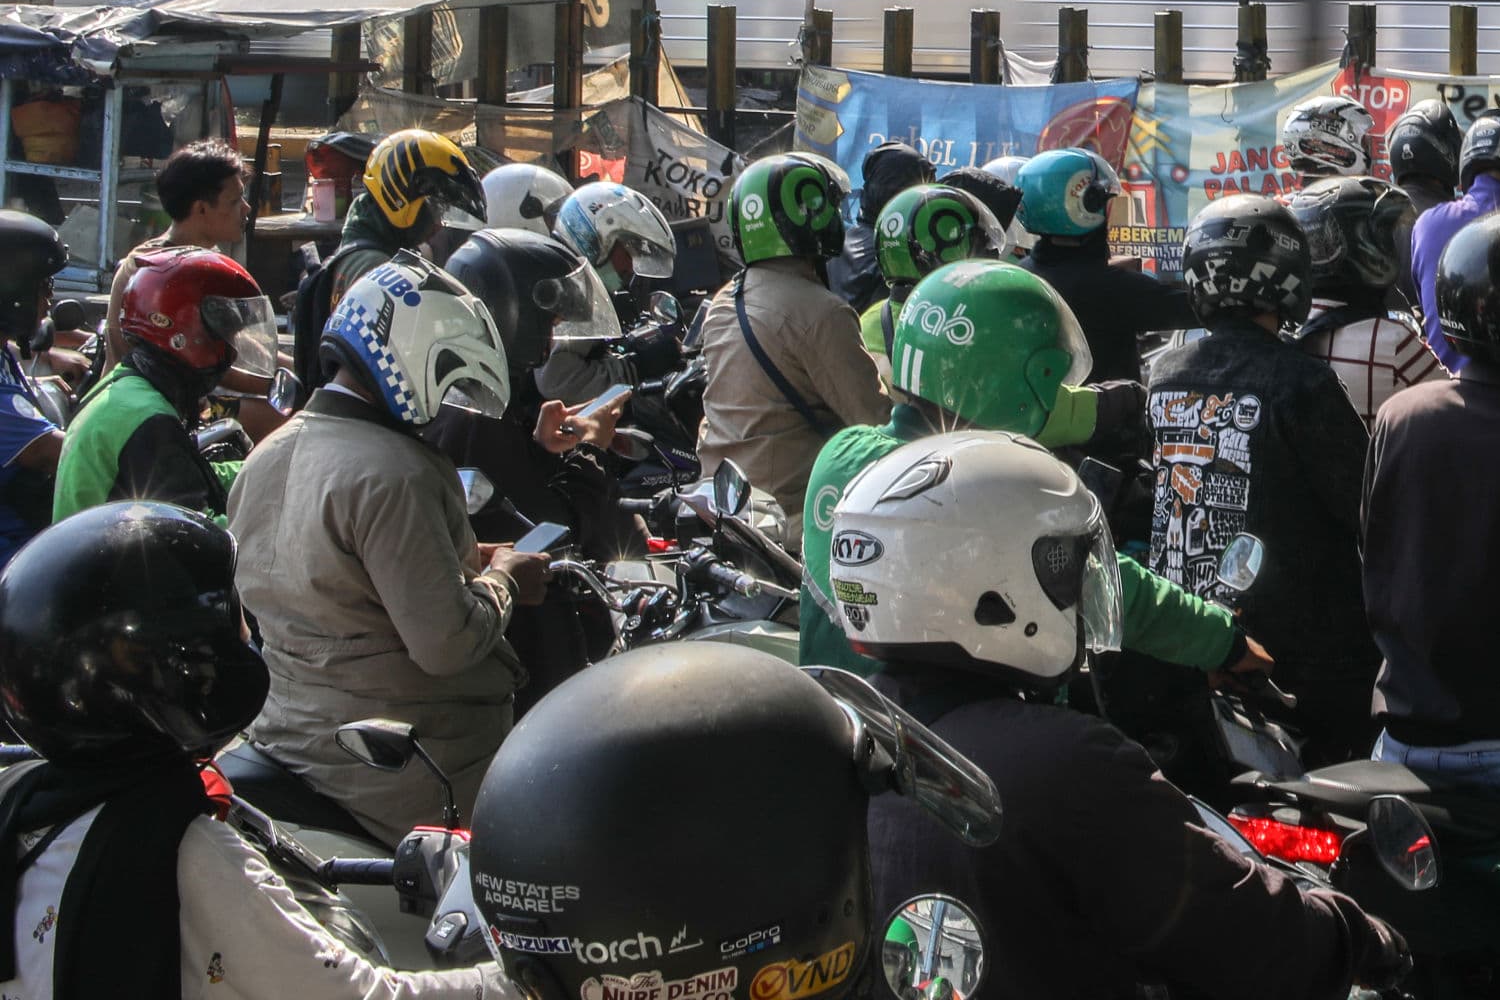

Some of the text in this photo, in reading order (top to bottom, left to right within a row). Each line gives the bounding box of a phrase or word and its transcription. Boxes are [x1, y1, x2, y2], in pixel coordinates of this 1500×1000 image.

[1340, 84, 1404, 109] STOP
[1210, 145, 1291, 175] JANG
[1204, 172, 1304, 200] PALAN
[1109, 227, 1184, 242] #BERTEM
[671, 447, 699, 462] HOND
[833, 539, 876, 559] KYT
[475, 872, 580, 900] NEW STATES
[485, 890, 564, 913] APPAREL
[501, 932, 572, 953] SUZUKI
[571, 932, 662, 964] torch
[720, 925, 780, 953] GoPro
[668, 969, 735, 1000] DENIM
[788, 950, 850, 994] VND
